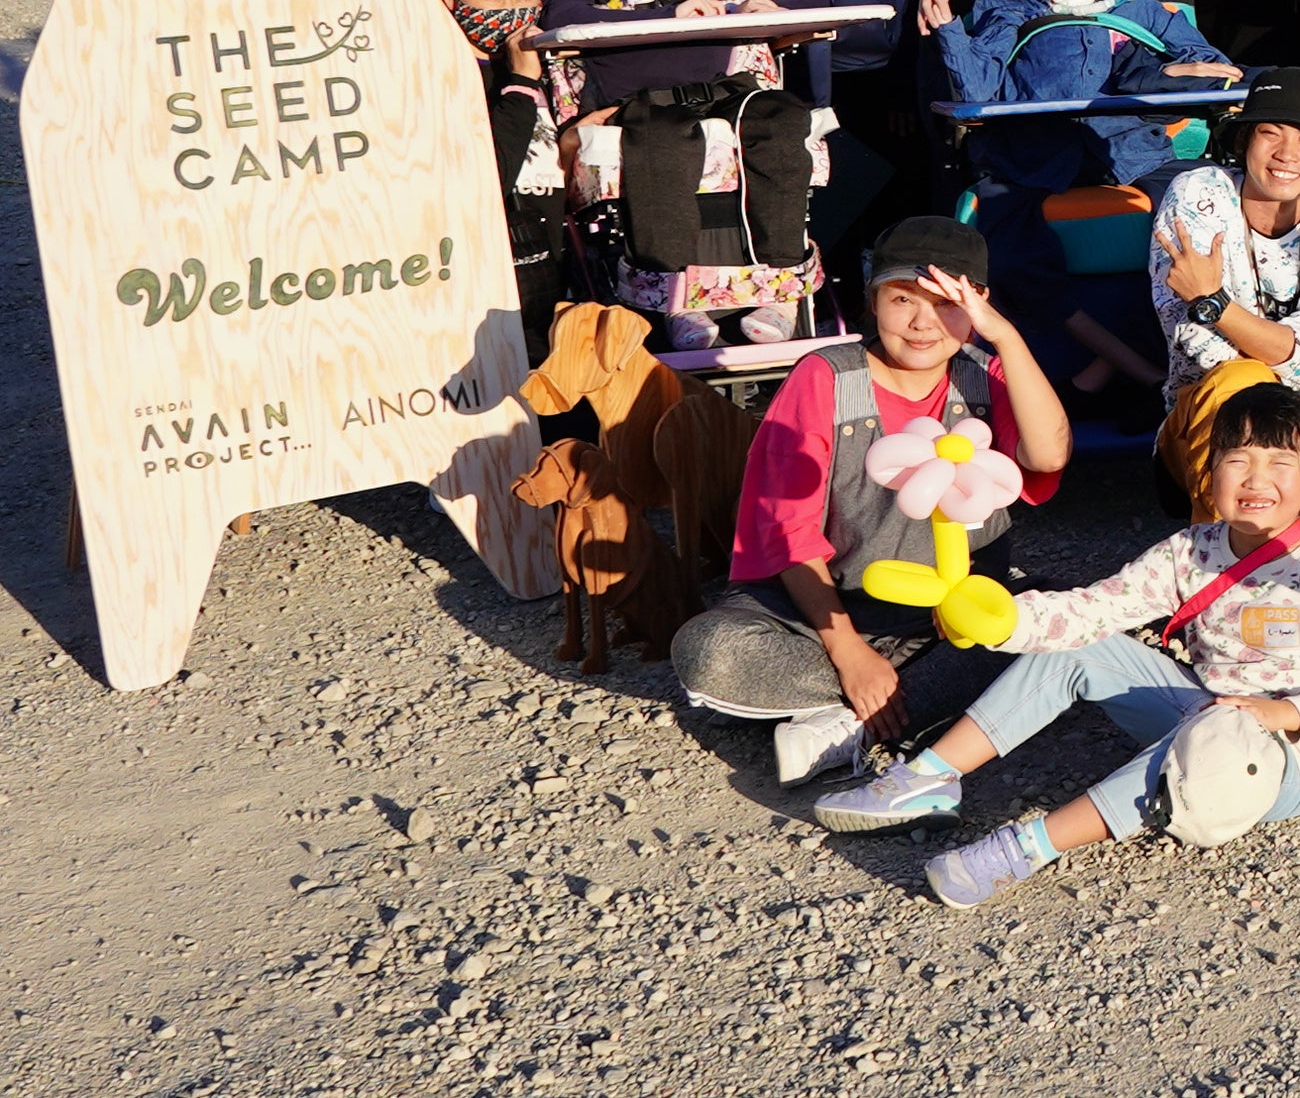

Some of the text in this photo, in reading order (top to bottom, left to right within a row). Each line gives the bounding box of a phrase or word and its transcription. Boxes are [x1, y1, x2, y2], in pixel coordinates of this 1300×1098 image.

[156, 25, 298, 77] THE
[166, 76, 362, 134] SEED
[173, 130, 370, 190] CAMP
[116, 237, 453, 327] Welcome!
[133, 399, 194, 418] SENDAI
[341, 378, 482, 432] AINOMI
[1265, 608, 1298, 621] PASS
